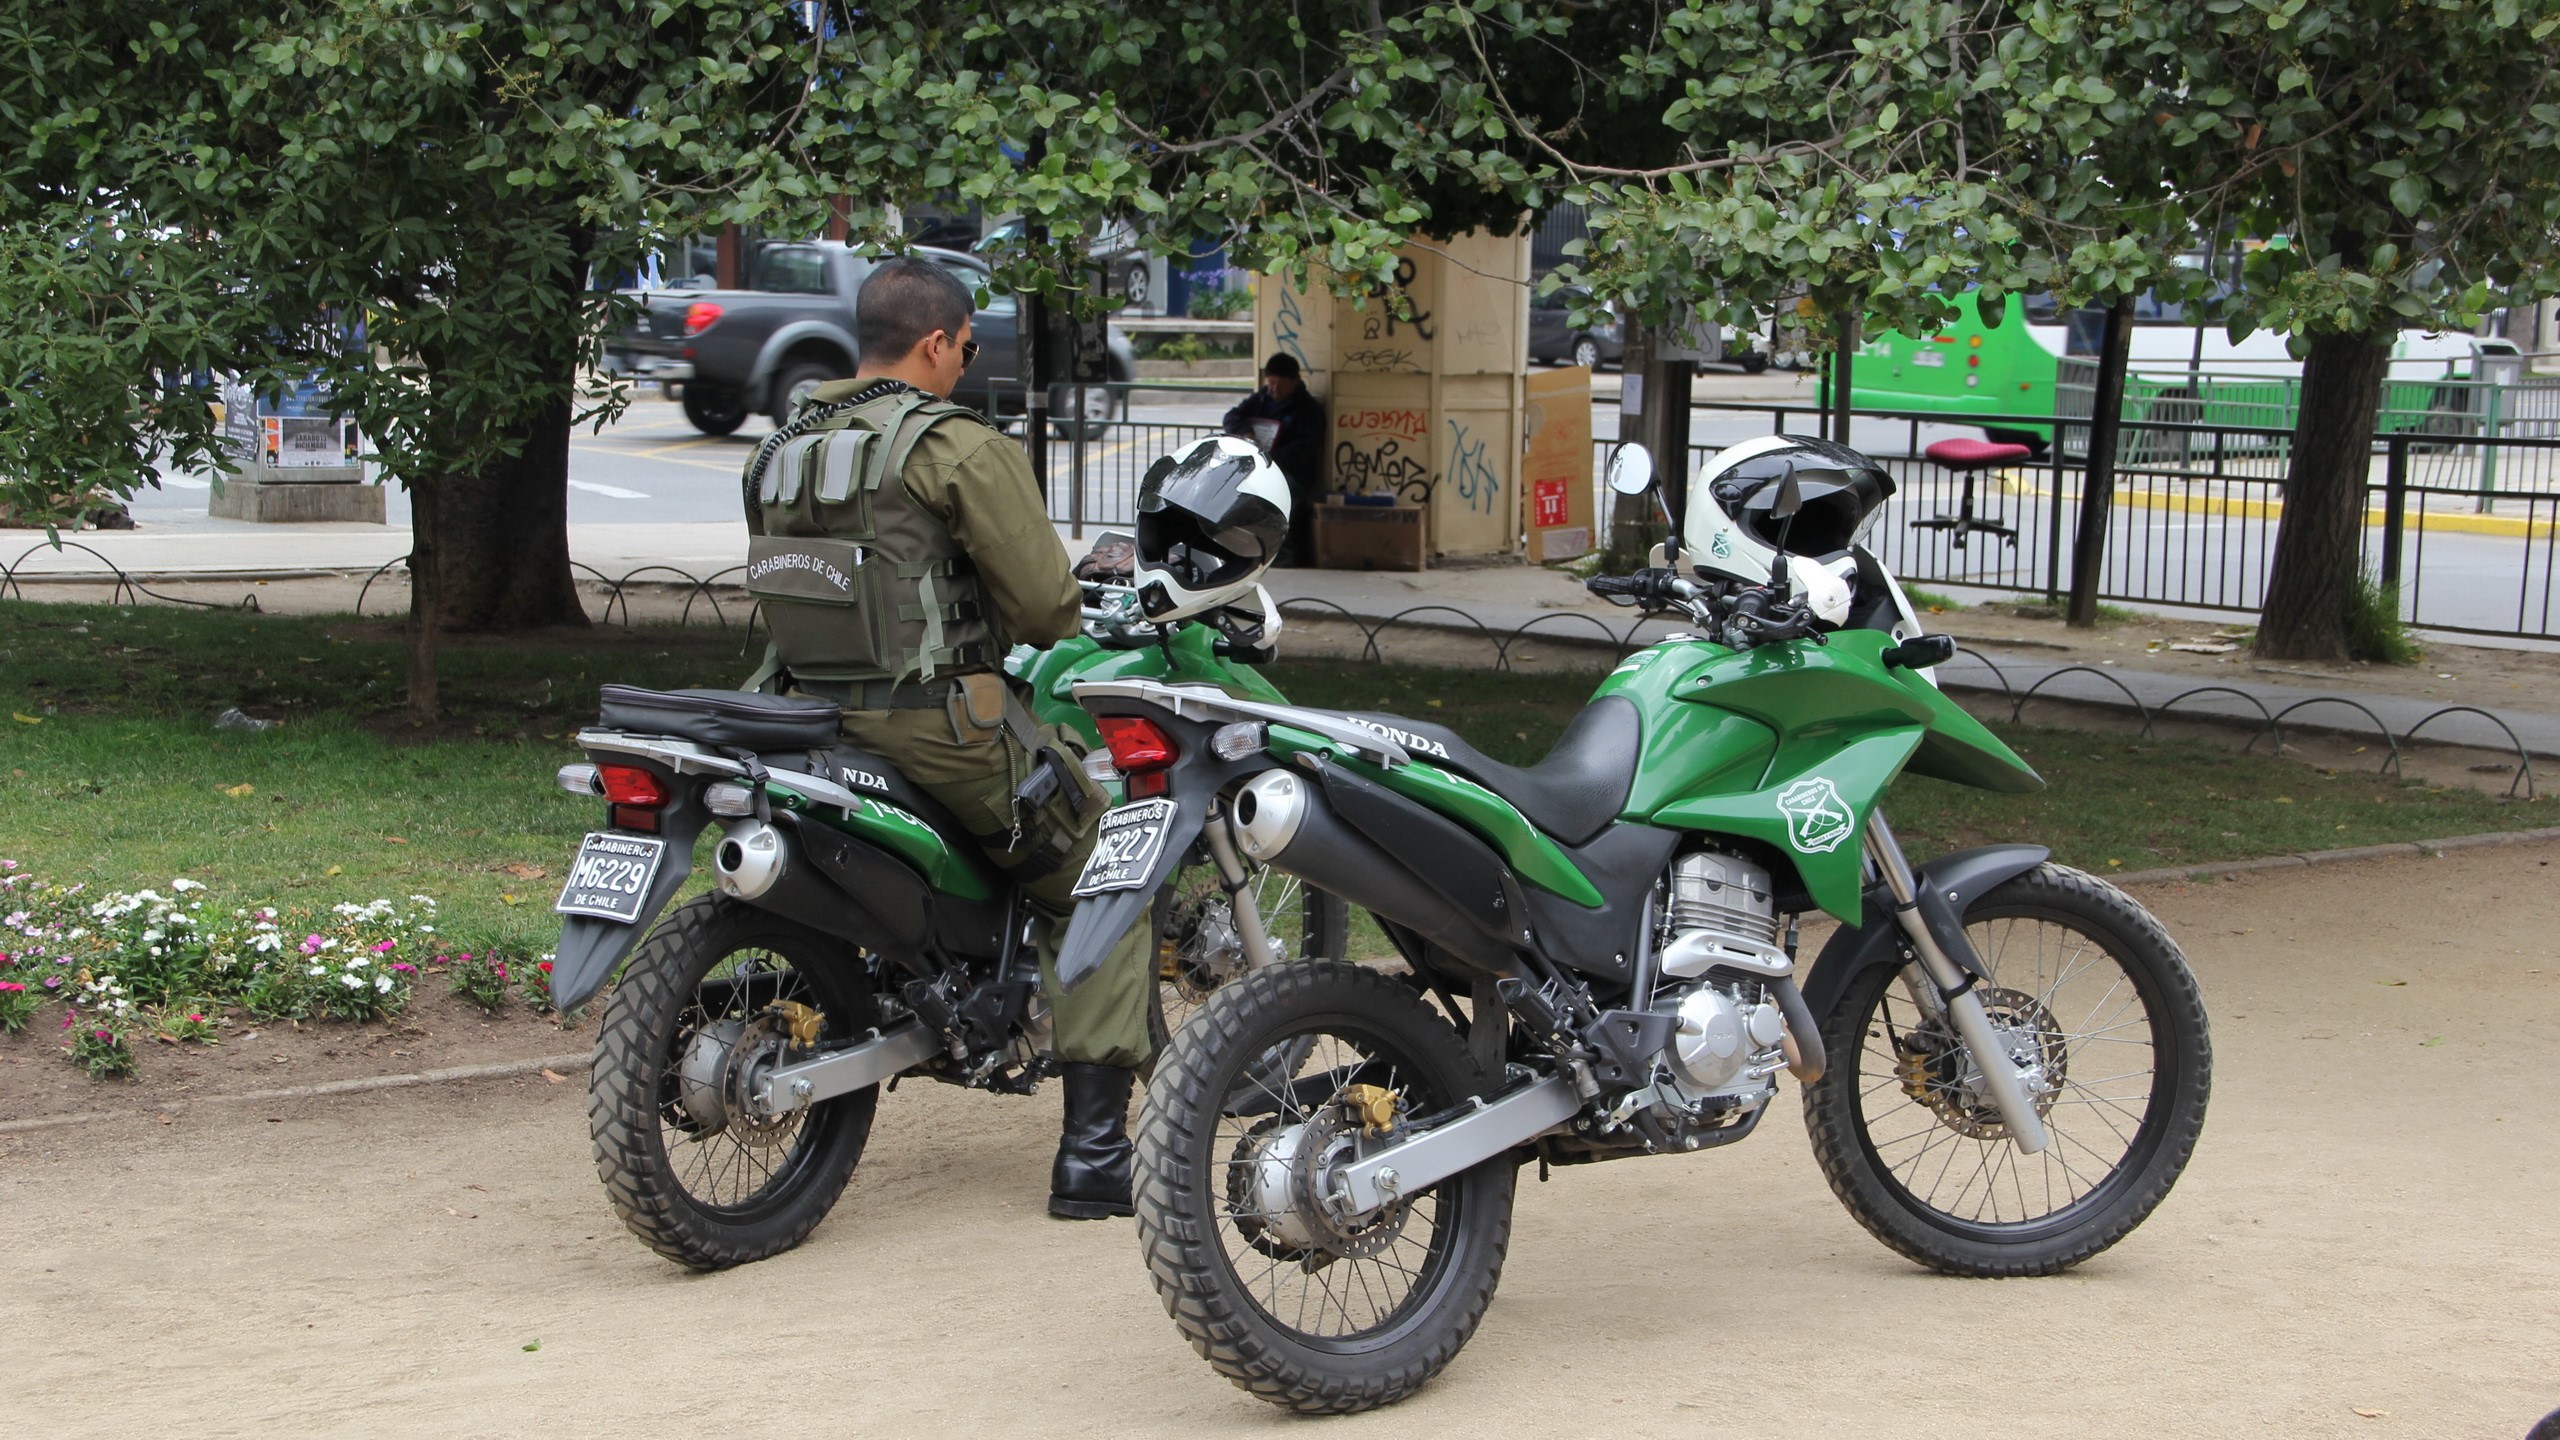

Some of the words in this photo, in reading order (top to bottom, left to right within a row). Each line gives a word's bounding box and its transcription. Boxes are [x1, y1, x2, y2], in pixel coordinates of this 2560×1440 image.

[750, 554, 810, 579] CARABINEROS
[812, 557, 826, 575] DE
[826, 565, 850, 591] CHILE
[1785, 786, 1818, 806] CARABINEROS
[1817, 784, 1826, 792] DE
[1801, 795, 1816, 806] CHILE
[1101, 807, 1163, 830] CARABINEROS
[586, 840, 654, 858] CARABINEROS
[1087, 826, 1159, 871] M6227
[571, 856, 646, 894] M6229
[1089, 873, 1102, 887] DE
[1101, 868, 1130, 882] CHILE
[574, 894, 588, 905] DE
[589, 895, 619, 909] CHILE
